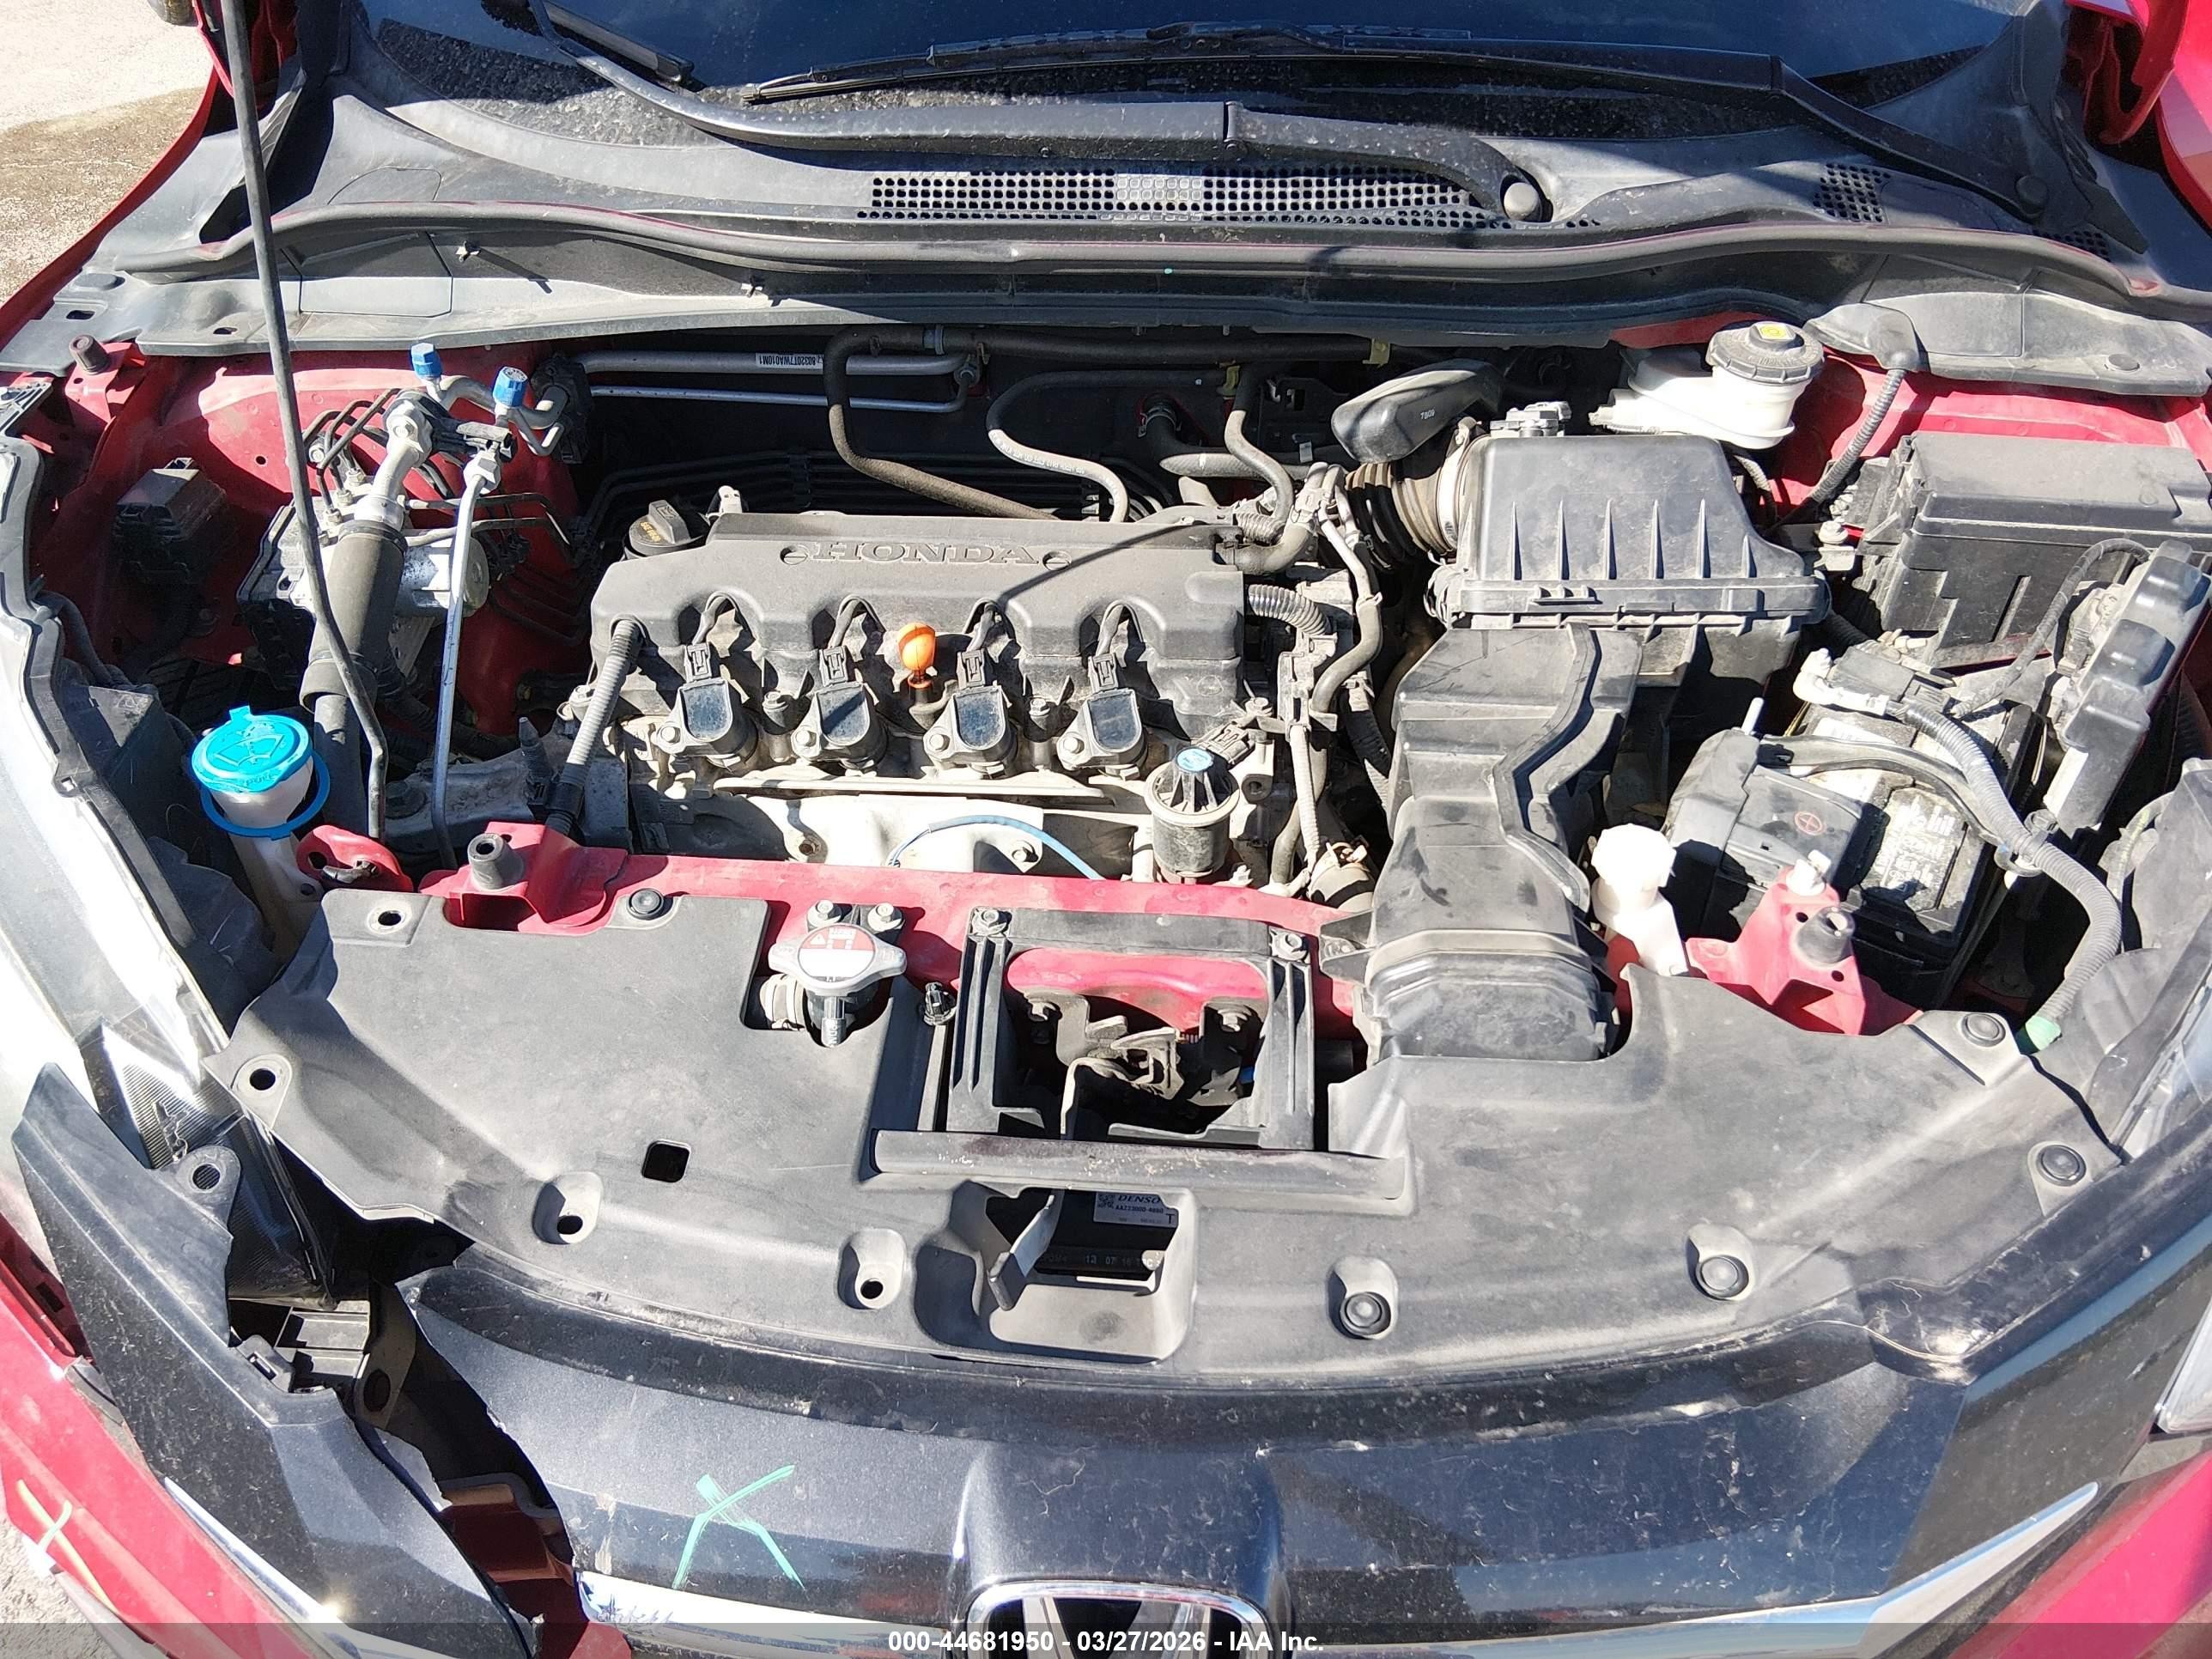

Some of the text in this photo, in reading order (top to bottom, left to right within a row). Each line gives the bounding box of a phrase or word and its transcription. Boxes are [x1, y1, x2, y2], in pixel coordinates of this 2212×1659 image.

[813, 542, 1039, 564] HONDA
[1118, 1194, 1160, 1203] DENSO
[1165, 1212, 1176, 1224] T
